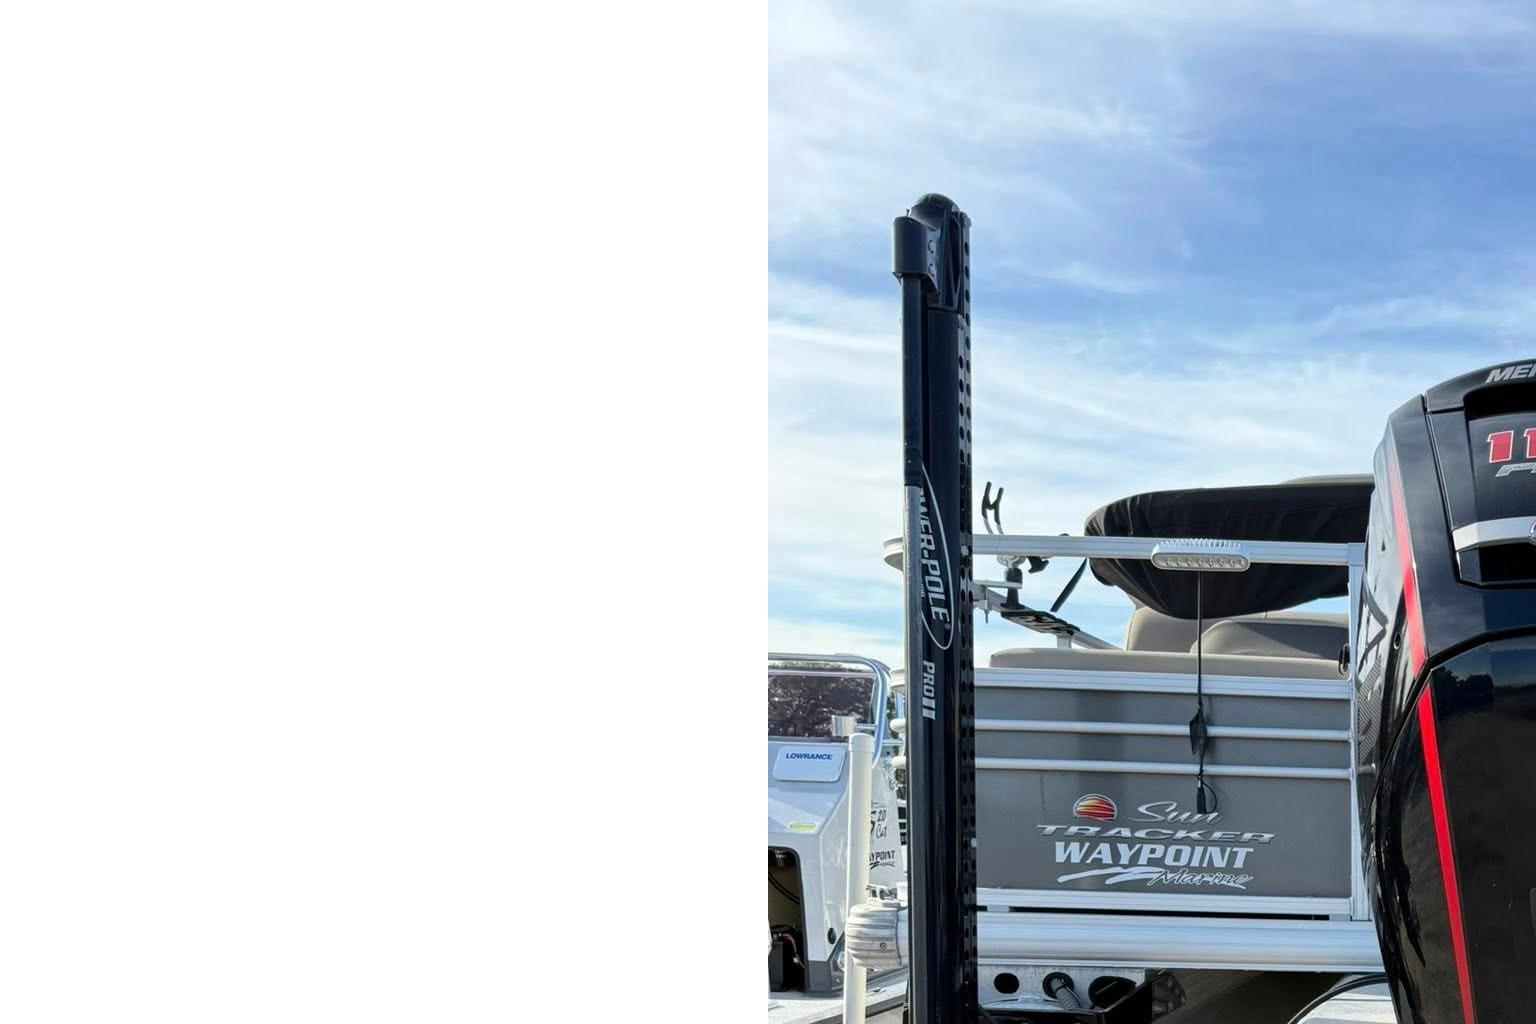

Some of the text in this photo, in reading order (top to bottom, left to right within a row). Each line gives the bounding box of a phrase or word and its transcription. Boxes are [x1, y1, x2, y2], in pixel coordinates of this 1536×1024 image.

[785, 752, 833, 760] LOWRANCE
[1125, 801, 1224, 825] Sun
[1036, 824, 1276, 844] TRACKER
[1054, 841, 1254, 869] WAYPOINT
